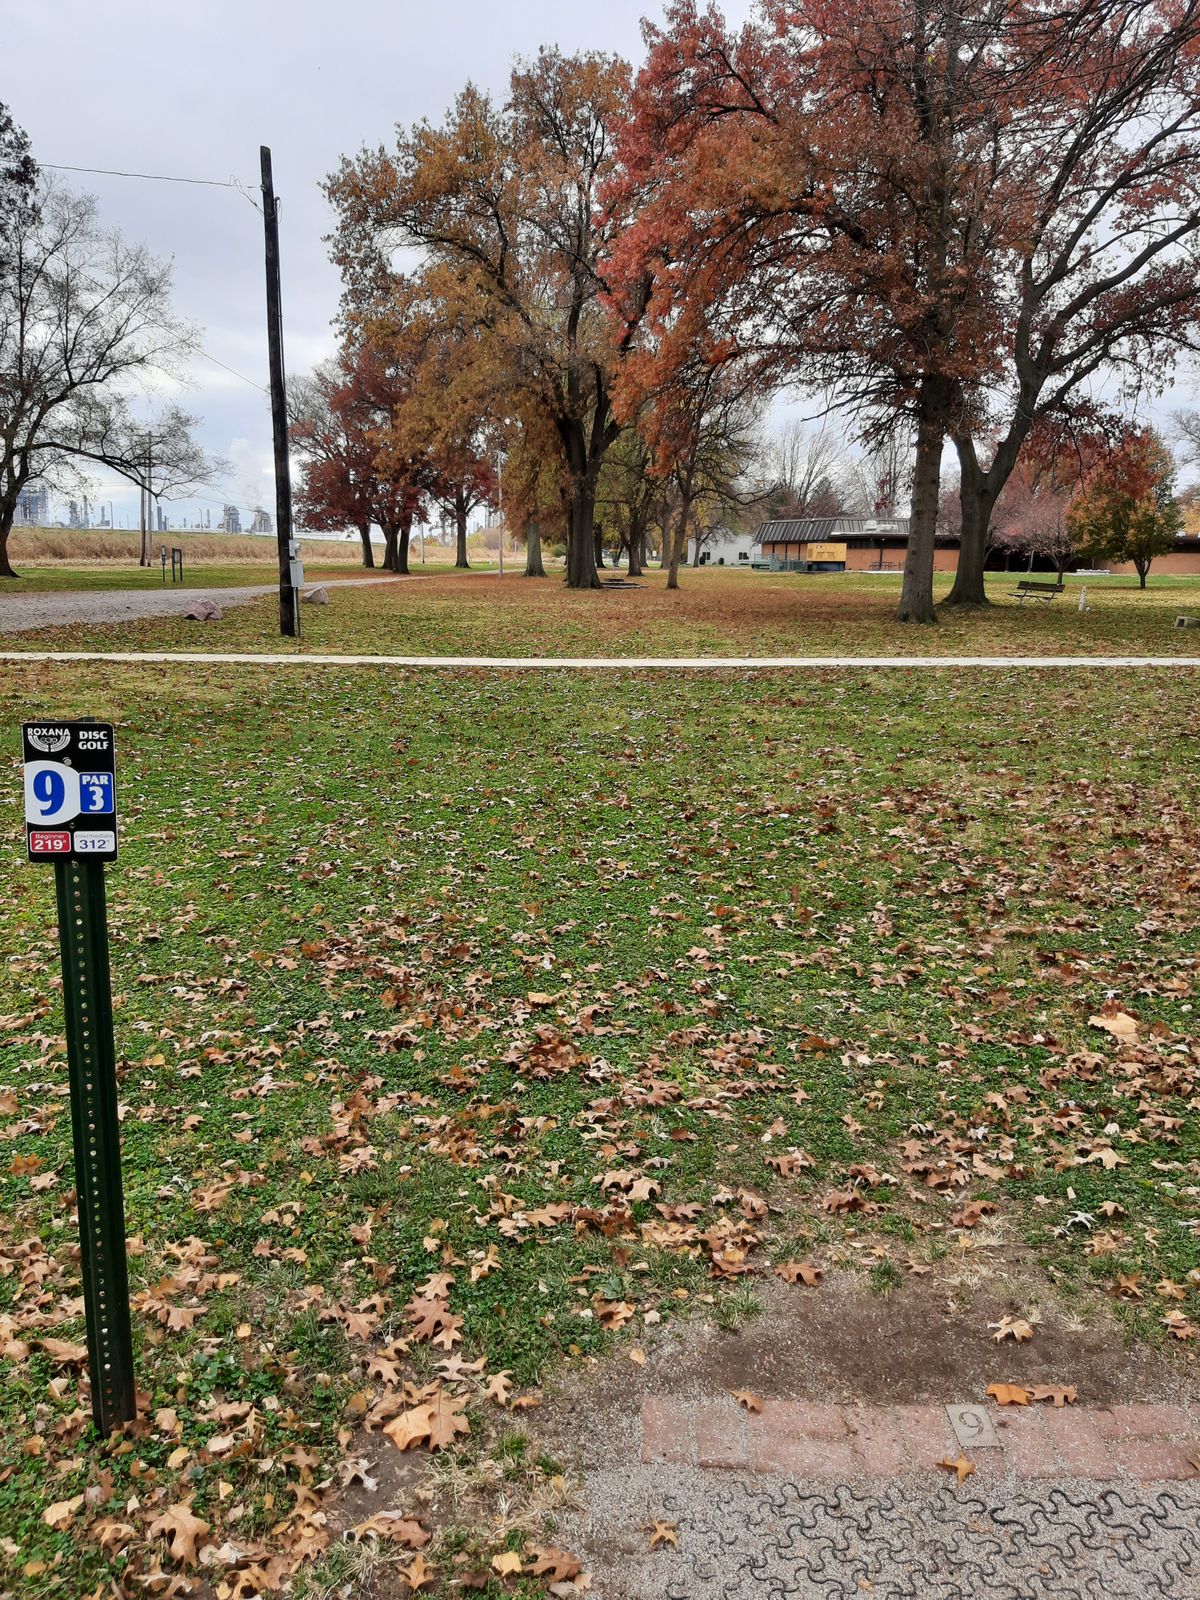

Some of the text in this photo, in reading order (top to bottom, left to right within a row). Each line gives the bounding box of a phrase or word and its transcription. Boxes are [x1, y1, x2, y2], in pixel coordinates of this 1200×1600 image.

[27, 728, 71, 736] ROXANA
[79, 731, 108, 740] DISC
[78, 741, 109, 750] GOLF
[82, 775, 109, 785] PAR
[33, 769, 65, 816] 9
[88, 786, 105, 811] 3
[958, 1411, 984, 1439] 9
